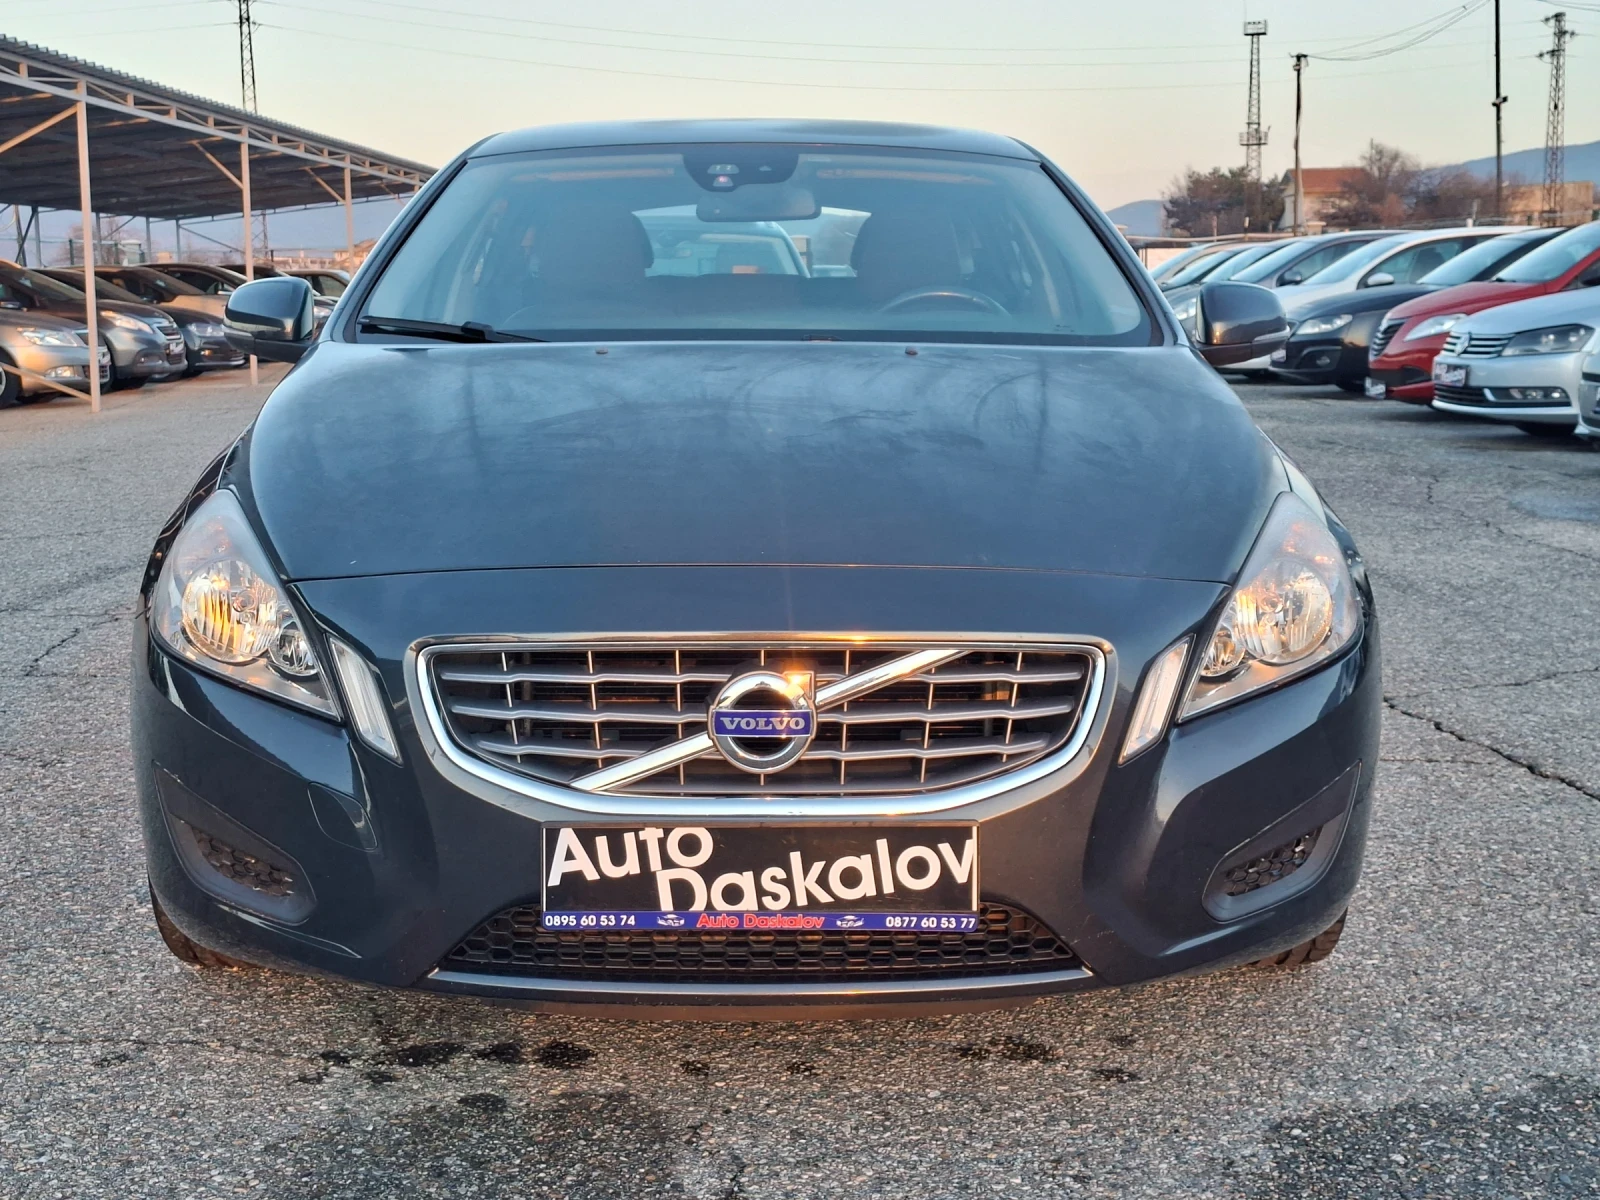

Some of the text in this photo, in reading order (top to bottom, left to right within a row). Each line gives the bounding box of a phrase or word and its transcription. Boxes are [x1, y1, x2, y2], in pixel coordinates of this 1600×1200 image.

[720, 717, 805, 730] VOLVO
[547, 827, 714, 887] Auto
[656, 838, 974, 912] Daskalov
[545, 915, 636, 926] 0895 60 53 74
[696, 913, 825, 928] Auto Daskalov
[885, 916, 976, 928] 0877 60 53 77
